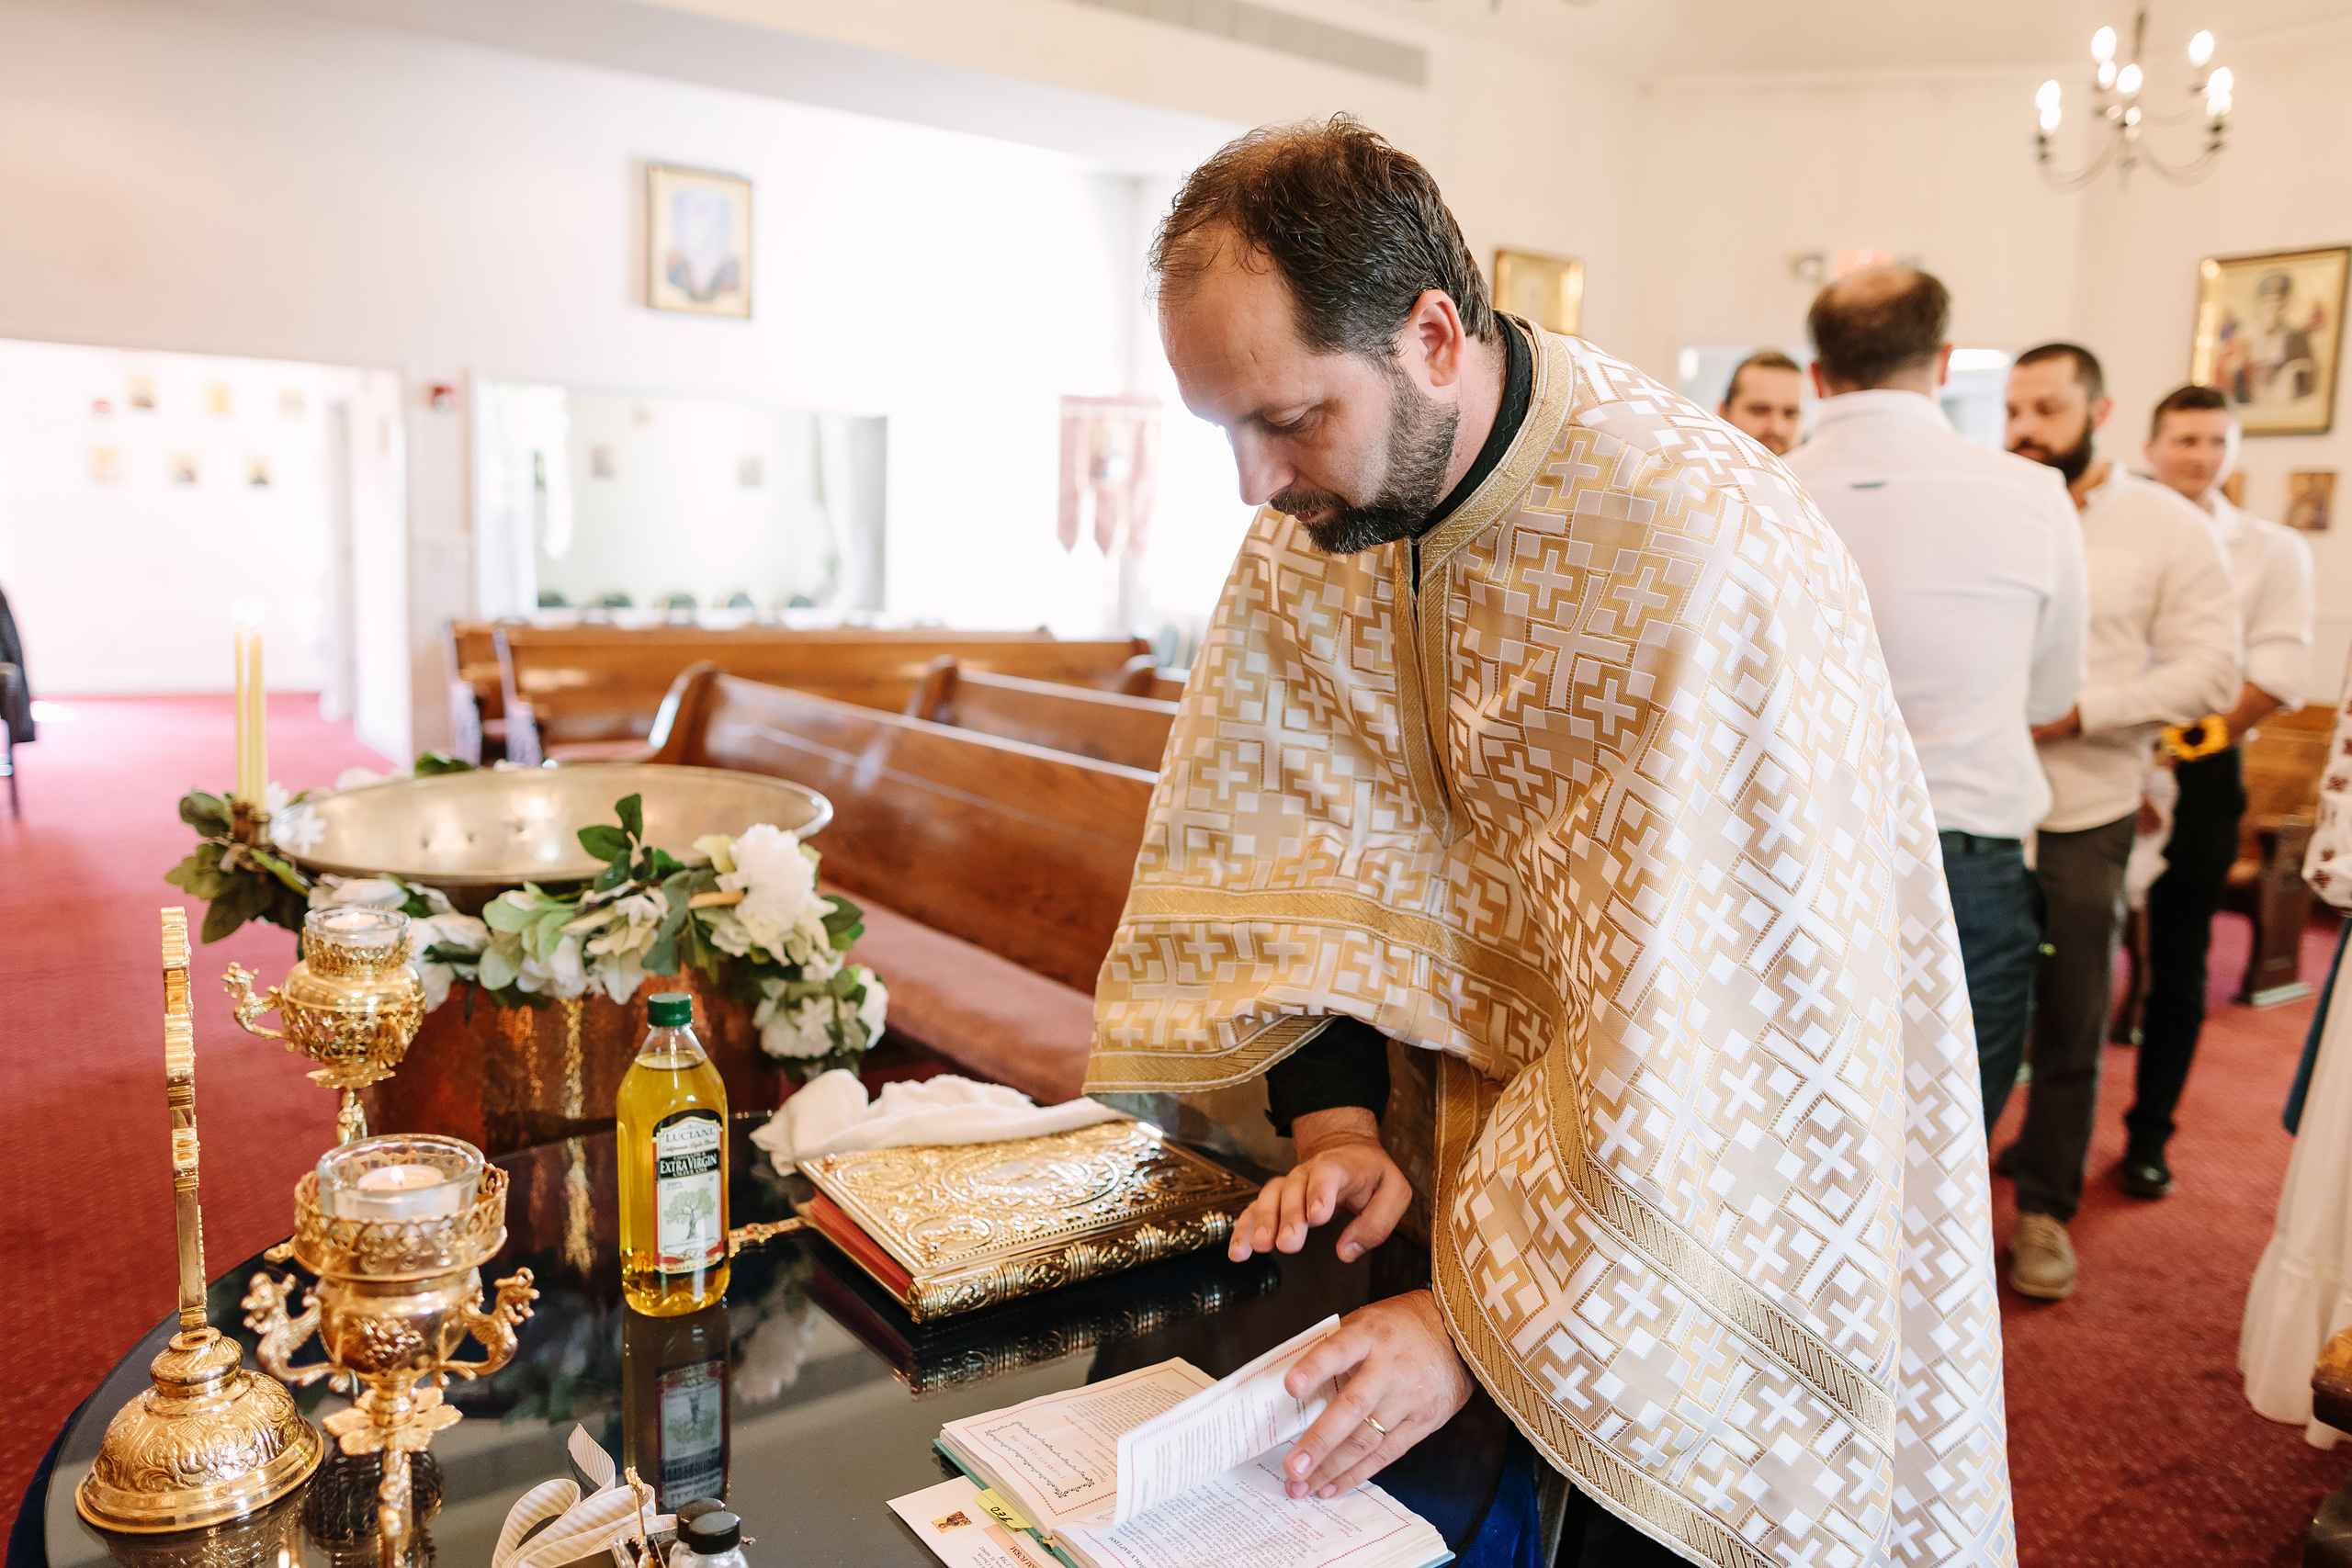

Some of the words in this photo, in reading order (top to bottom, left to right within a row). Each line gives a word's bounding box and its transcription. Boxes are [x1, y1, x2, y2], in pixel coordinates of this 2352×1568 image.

[660, 1159, 688, 1175] EXTRA
[687, 1154, 717, 1170] VIRGIN
[1010, 1546, 1027, 1562] FORM
[1108, 1536, 1132, 1555] BAPTISM
